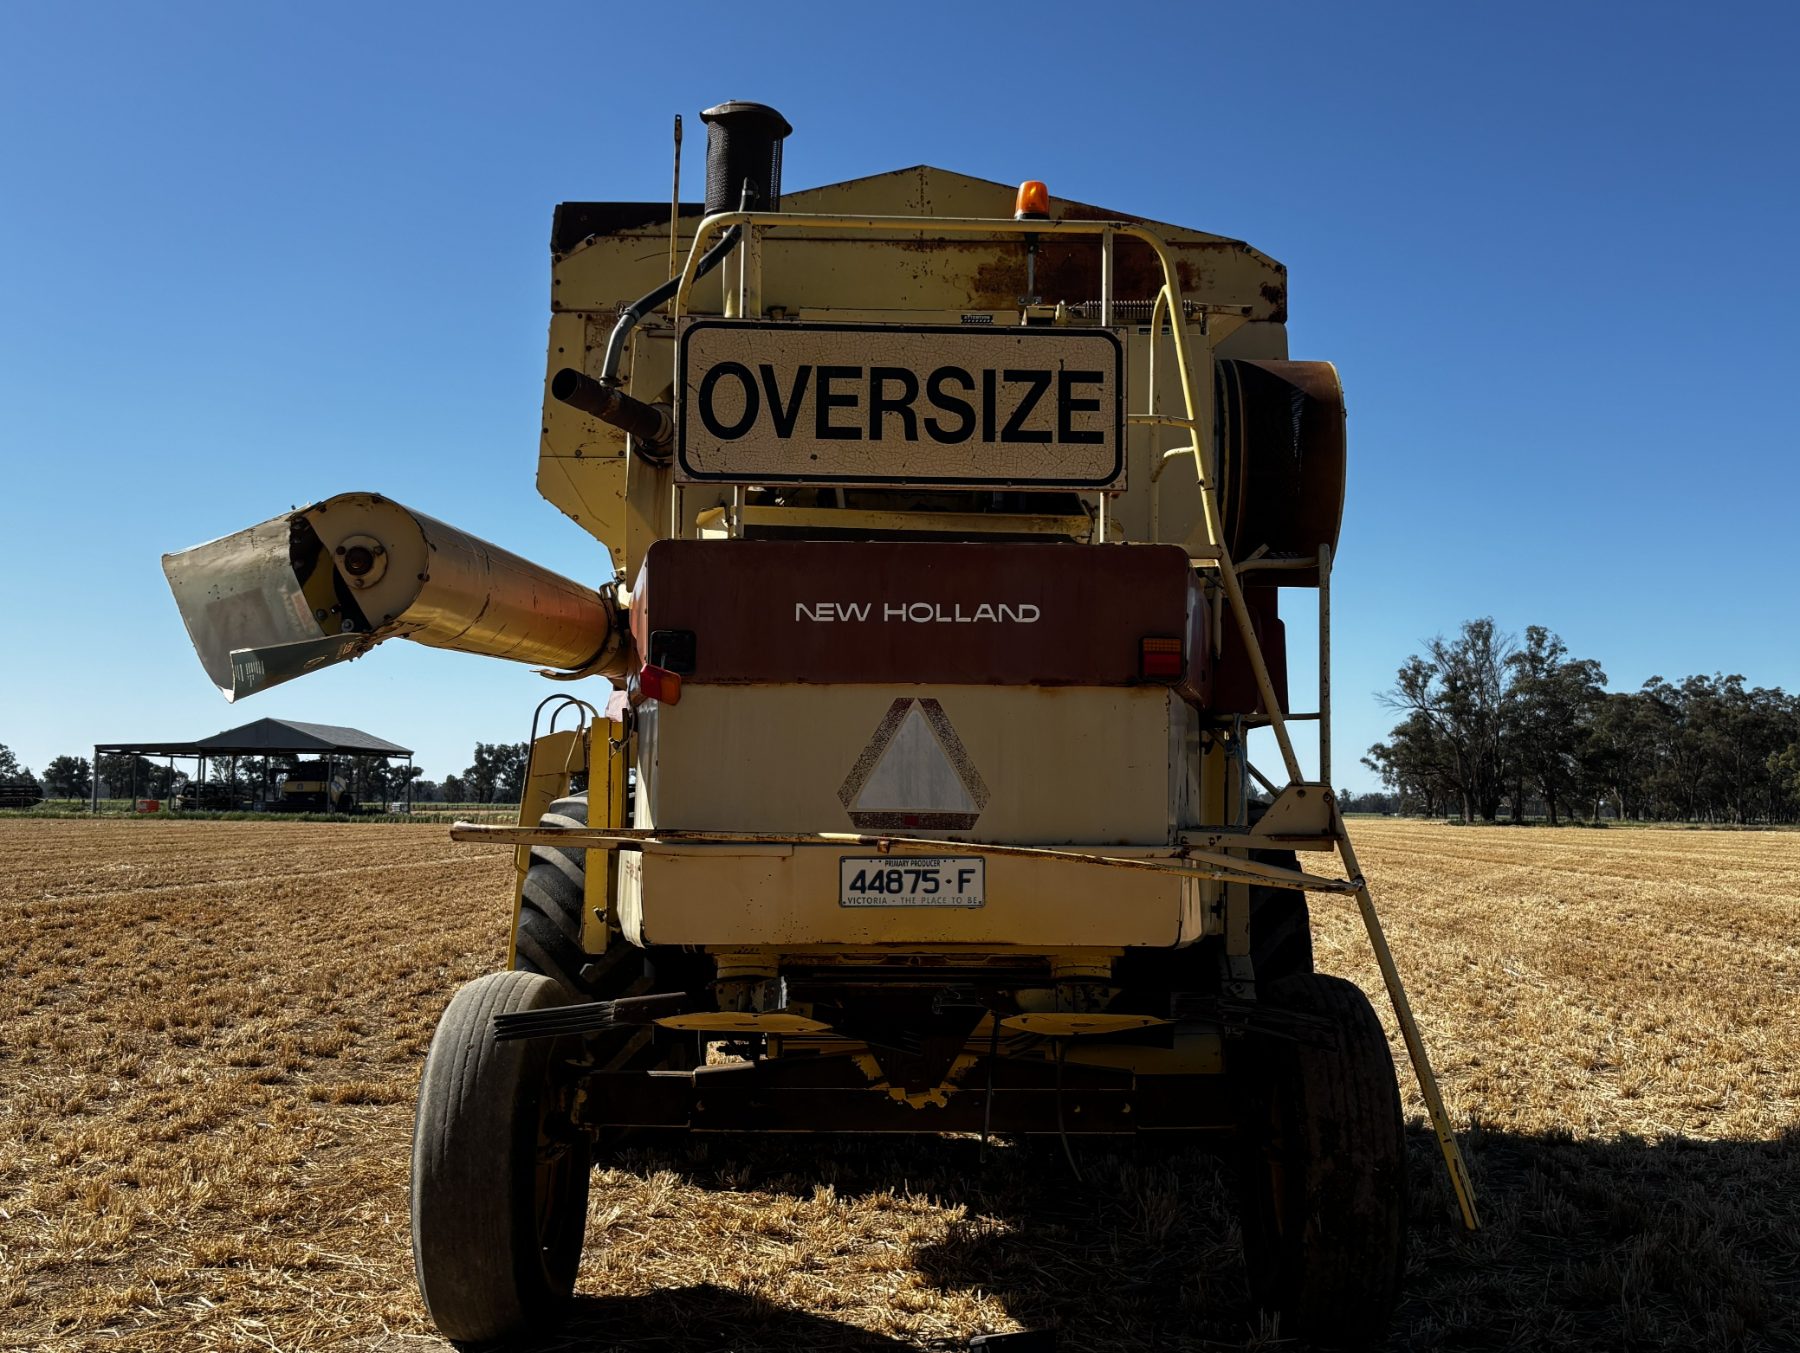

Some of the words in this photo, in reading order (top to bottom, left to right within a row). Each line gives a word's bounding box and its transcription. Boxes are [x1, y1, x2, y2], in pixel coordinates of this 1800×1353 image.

[699, 361, 1105, 445] OVERSIZE
[795, 602, 872, 622] NEW
[883, 602, 1041, 623] HOLLAND
[884, 859, 909, 867] PRIMARY
[910, 859, 941, 867] PRODUCER
[847, 896, 888, 905] VICTORIA
[900, 896, 916, 905] THE
[921, 896, 947, 905] PLACE
[951, 896, 963, 905] TO
[967, 896, 978, 904] BE
